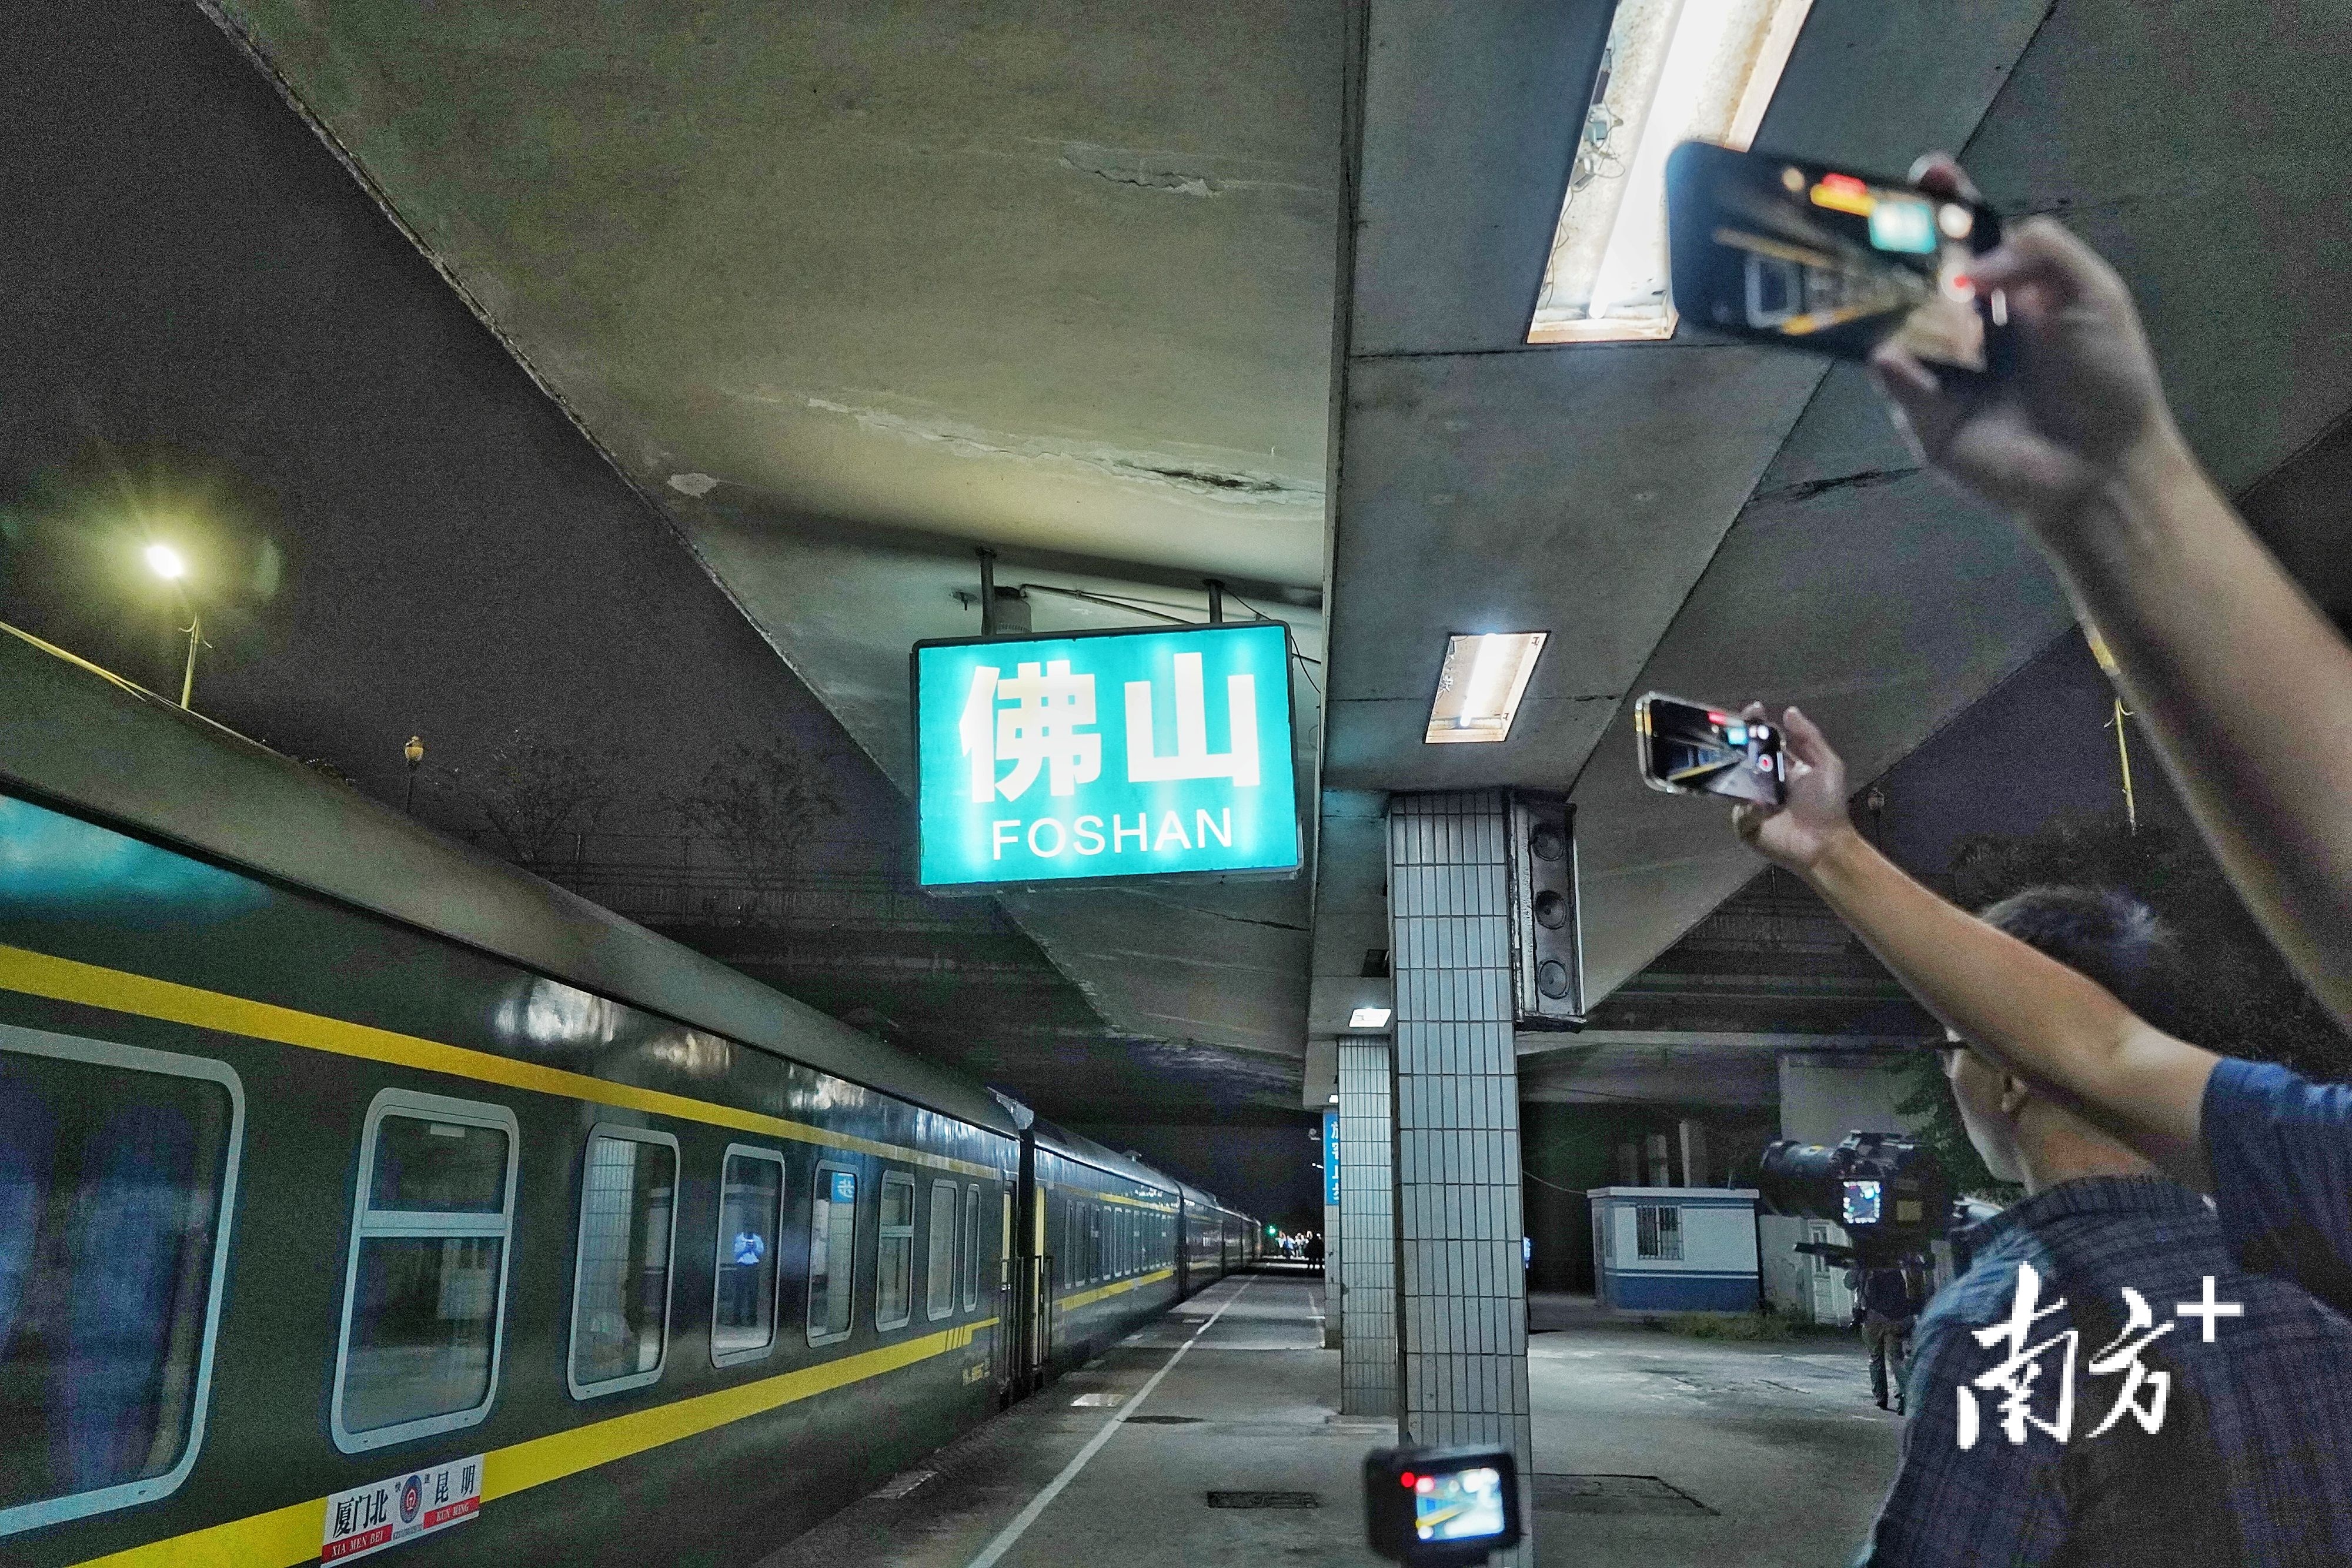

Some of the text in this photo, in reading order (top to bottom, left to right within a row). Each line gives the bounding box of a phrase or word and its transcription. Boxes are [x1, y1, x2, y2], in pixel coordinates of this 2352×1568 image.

[959, 652, 1261, 803] 佛山
[993, 808, 1232, 860] FOSHAN
[435, 1464, 475, 1504] 昆明
[333, 1489, 388, 1538] 厦门北
[332, 1543, 346, 1557] XIA
[350, 1536, 368, 1551] MEN
[370, 1530, 384, 1544] BEI
